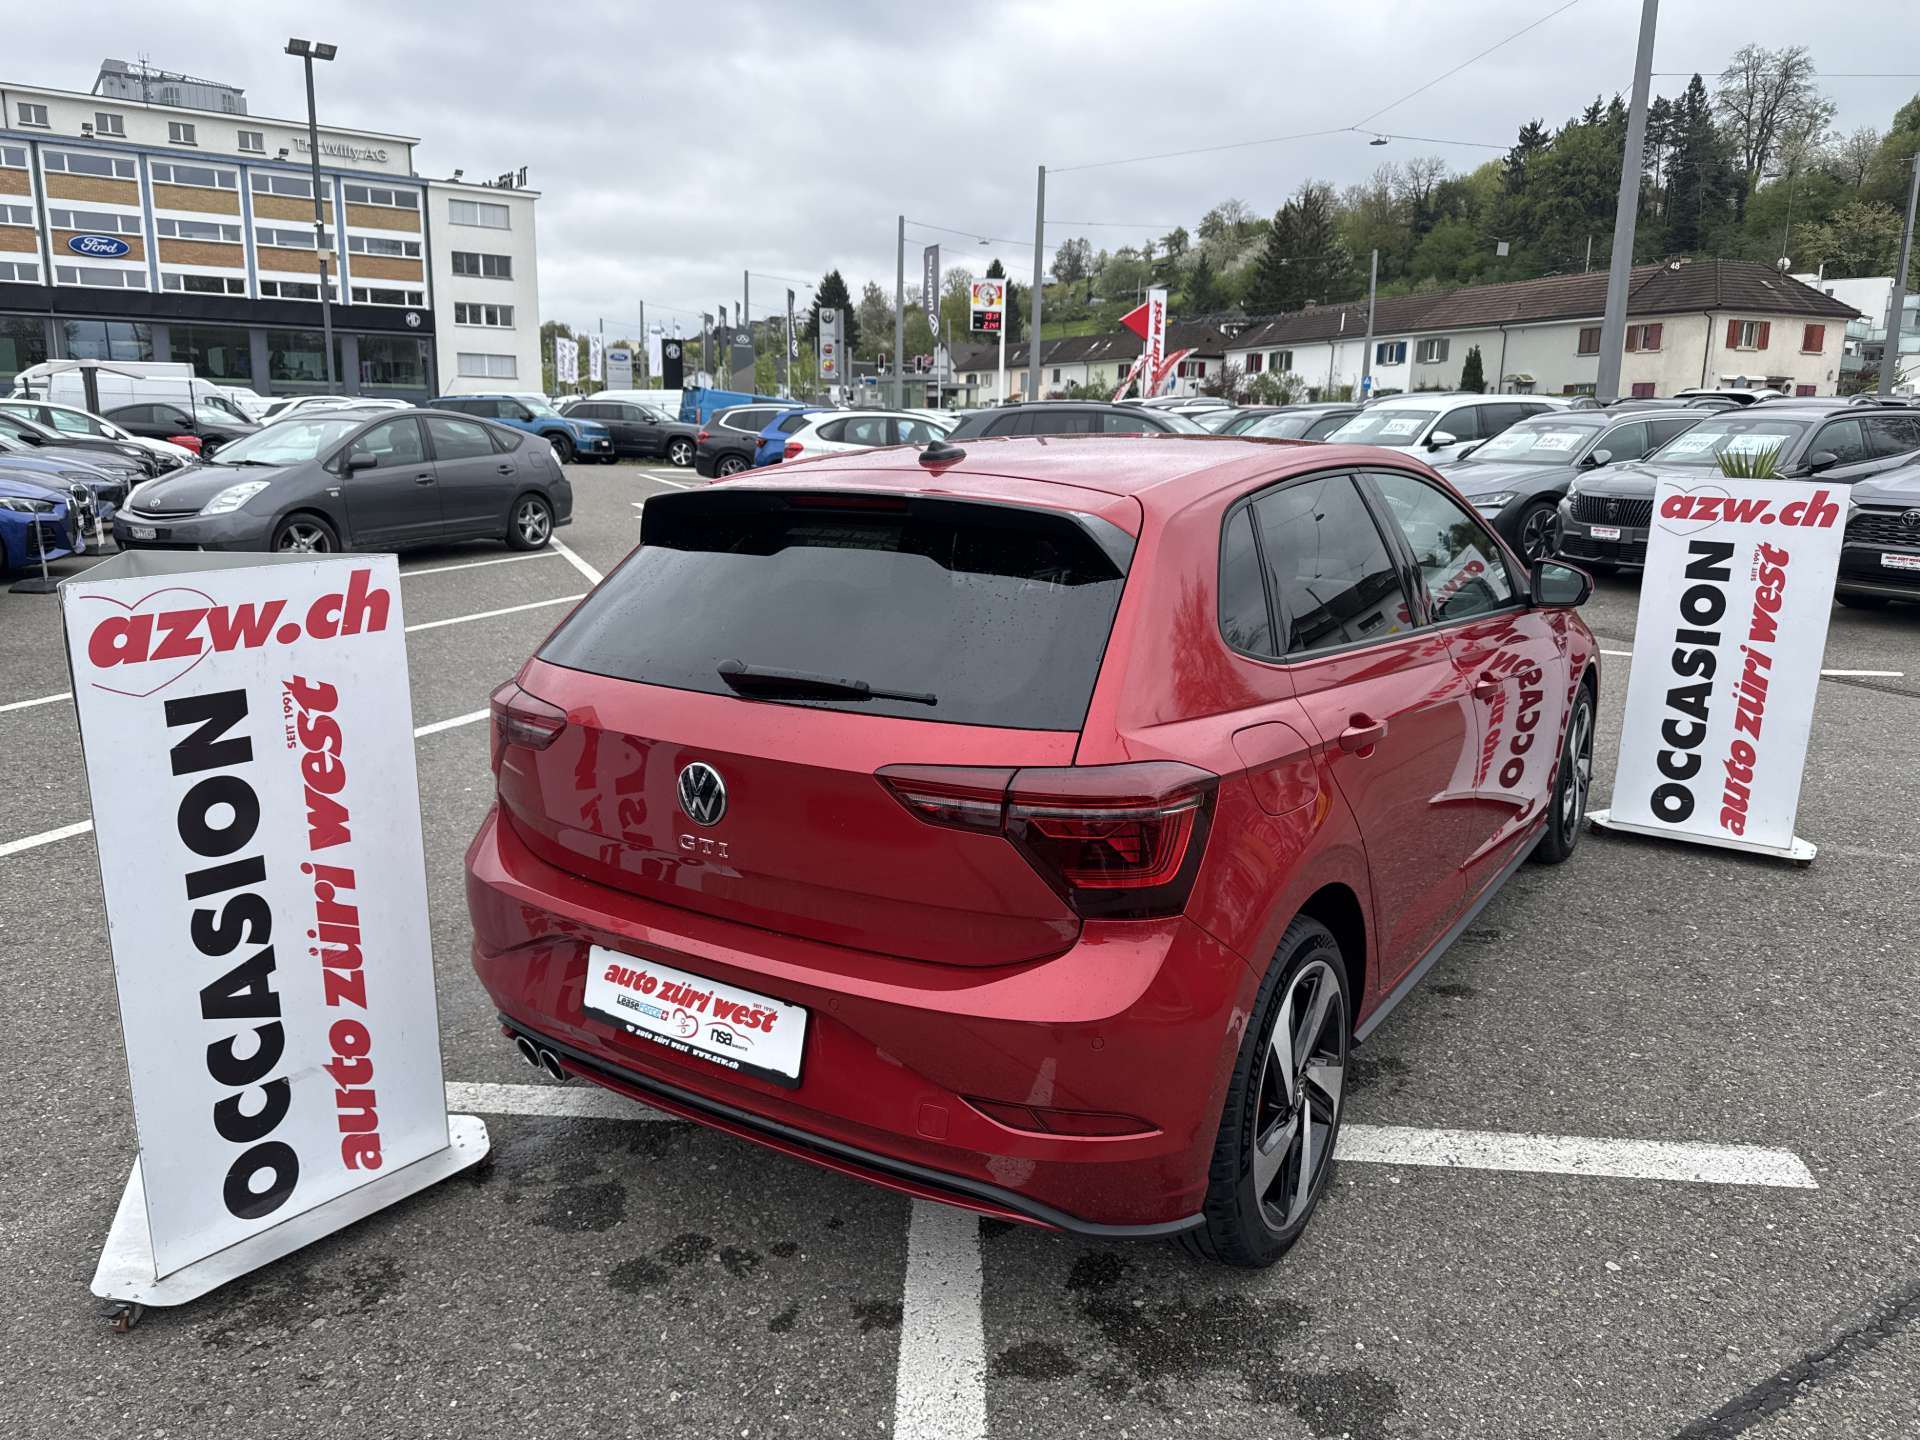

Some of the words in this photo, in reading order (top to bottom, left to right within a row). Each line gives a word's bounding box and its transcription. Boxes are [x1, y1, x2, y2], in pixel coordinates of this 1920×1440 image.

[321, 141, 360, 161] Willy
[363, 148, 388, 162] AG
[1660, 490, 1840, 528] azw.ch
[1748, 542, 1790, 643] west
[1750, 564, 1760, 582] SEIT
[88, 569, 391, 668] azw.ch
[282, 690, 294, 722] 1991
[1650, 540, 1735, 823] OCCASION
[1732, 643, 1772, 741] züri
[281, 674, 352, 852] west
[286, 724, 297, 749] SEIT
[1720, 739, 1757, 836] auto
[680, 834, 728, 858] GTI
[164, 688, 300, 1220] OCCASION
[300, 861, 367, 1010] züri
[604, 964, 658, 994] auto
[656, 981, 714, 1013] züri
[713, 997, 779, 1033] west
[710, 1028, 733, 1046] nsa
[636, 1028, 653, 1040] auto
[670, 1042, 689, 1053] west
[322, 1018, 383, 1170] auto
